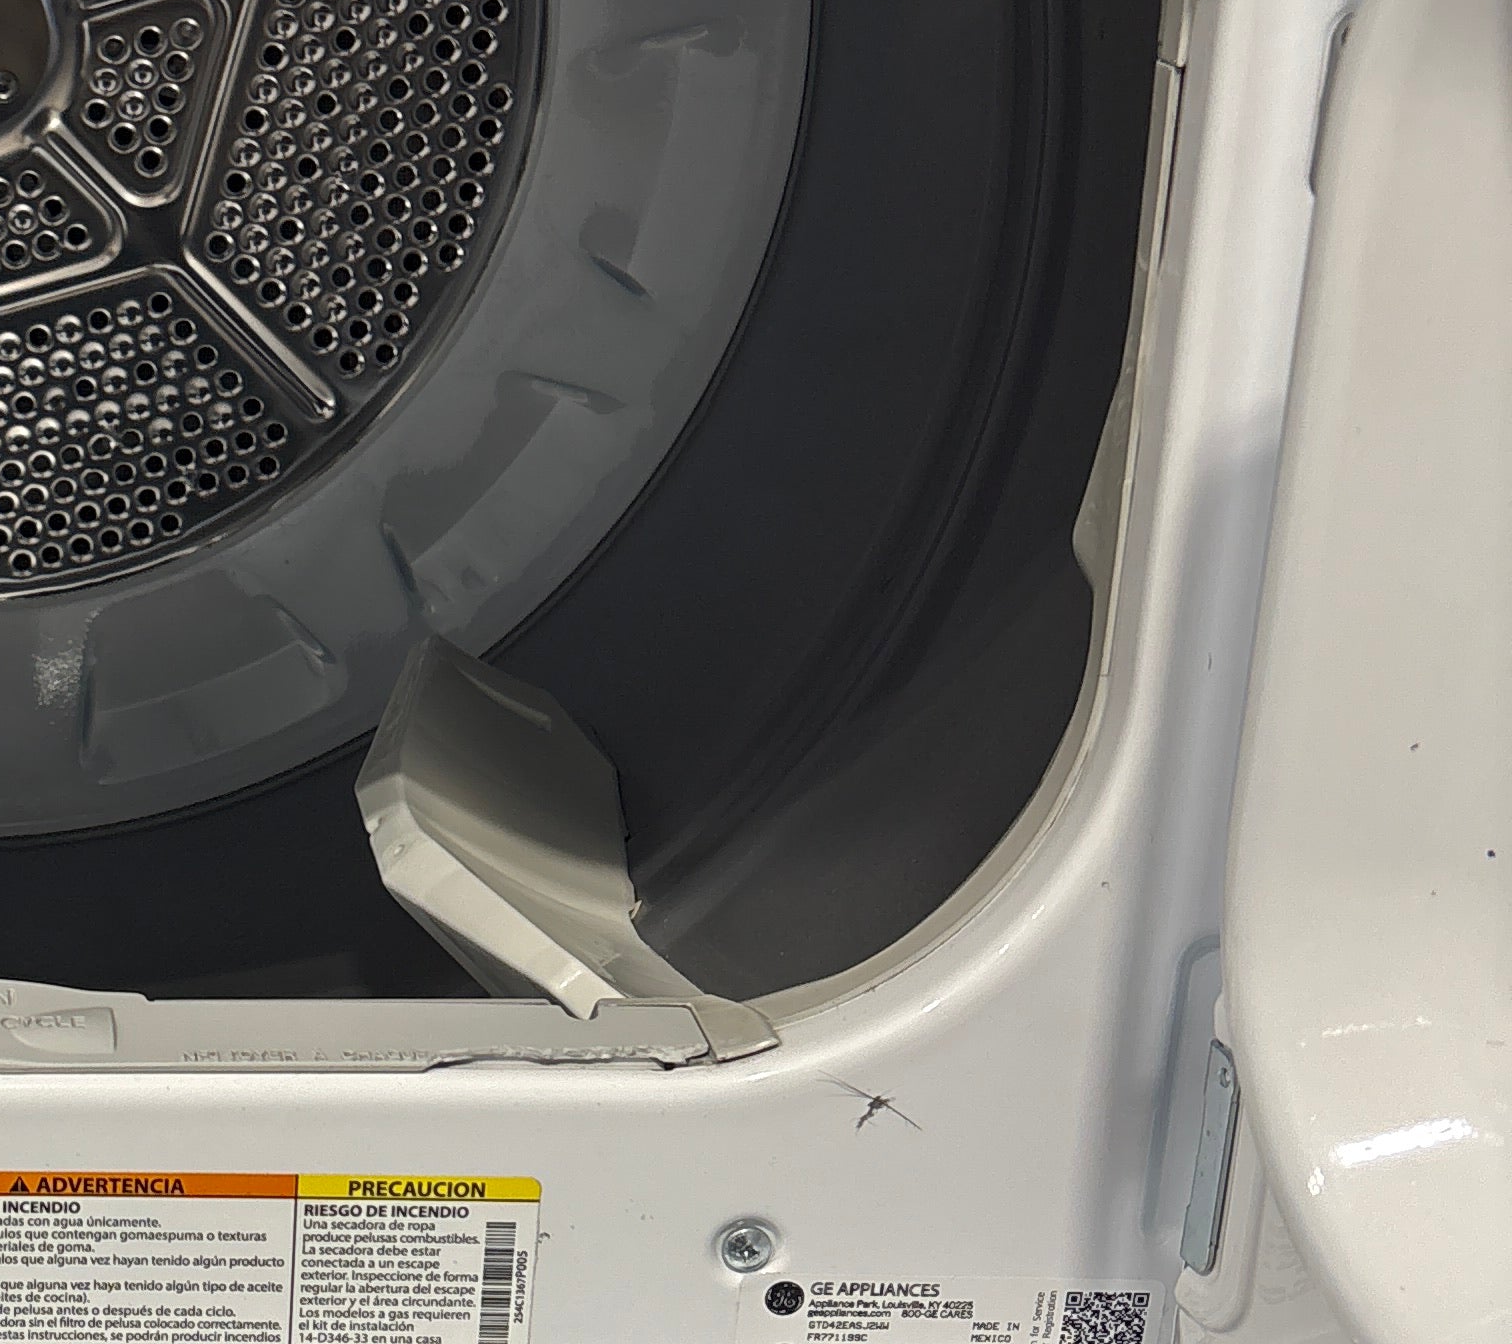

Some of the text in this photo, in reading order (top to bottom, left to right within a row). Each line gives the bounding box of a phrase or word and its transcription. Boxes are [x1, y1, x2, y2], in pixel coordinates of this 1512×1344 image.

[0, 1016, 86, 1029] CYCLE
[36, 1177, 184, 1194] ADVERTENCIA
[348, 1181, 486, 1198] PRECAUCION
[2, 1202, 80, 1214] INCENDIO
[303, 1205, 469, 1217] RIESGO DE INCENDIO
[27, 1218, 50, 1227] con
[53, 1218, 83, 1230] agua
[86, 1216, 161, 1228] únicamente.
[303, 1219, 435, 1232] Una secadora de ropa
[24, 1231, 48, 1242] que
[51, 1229, 117, 1243] contengan
[119, 1232, 203, 1243] gomaespuma
[217, 1231, 267, 1241] texturas
[302, 1232, 480, 1245] produce pelusas combustibles.
[37, 1241, 54, 1252] de
[56, 1244, 95, 1255] goma.
[301, 1245, 441, 1256] La secadora debe estar
[300, 1258, 365, 1268] conectada
[378, 1260, 394, 1268] un
[397, 1260, 440, 1271] escape
[810, 1282, 941, 1297] GE APPLIANCES
[808, 1300, 855, 1310] Appliance
[856, 1300, 880, 1309] Park,
[881, 1300, 926, 1309] Louisville,
[1033, 1291, 1046, 1322] Service
[807, 1310, 974, 1319] geappliances.com 800-GE CARES
[1043, 1290, 1058, 1340] Registration
[972, 1322, 1020, 1331] MADE IN
[970, 1334, 1012, 1343] MEXICO
